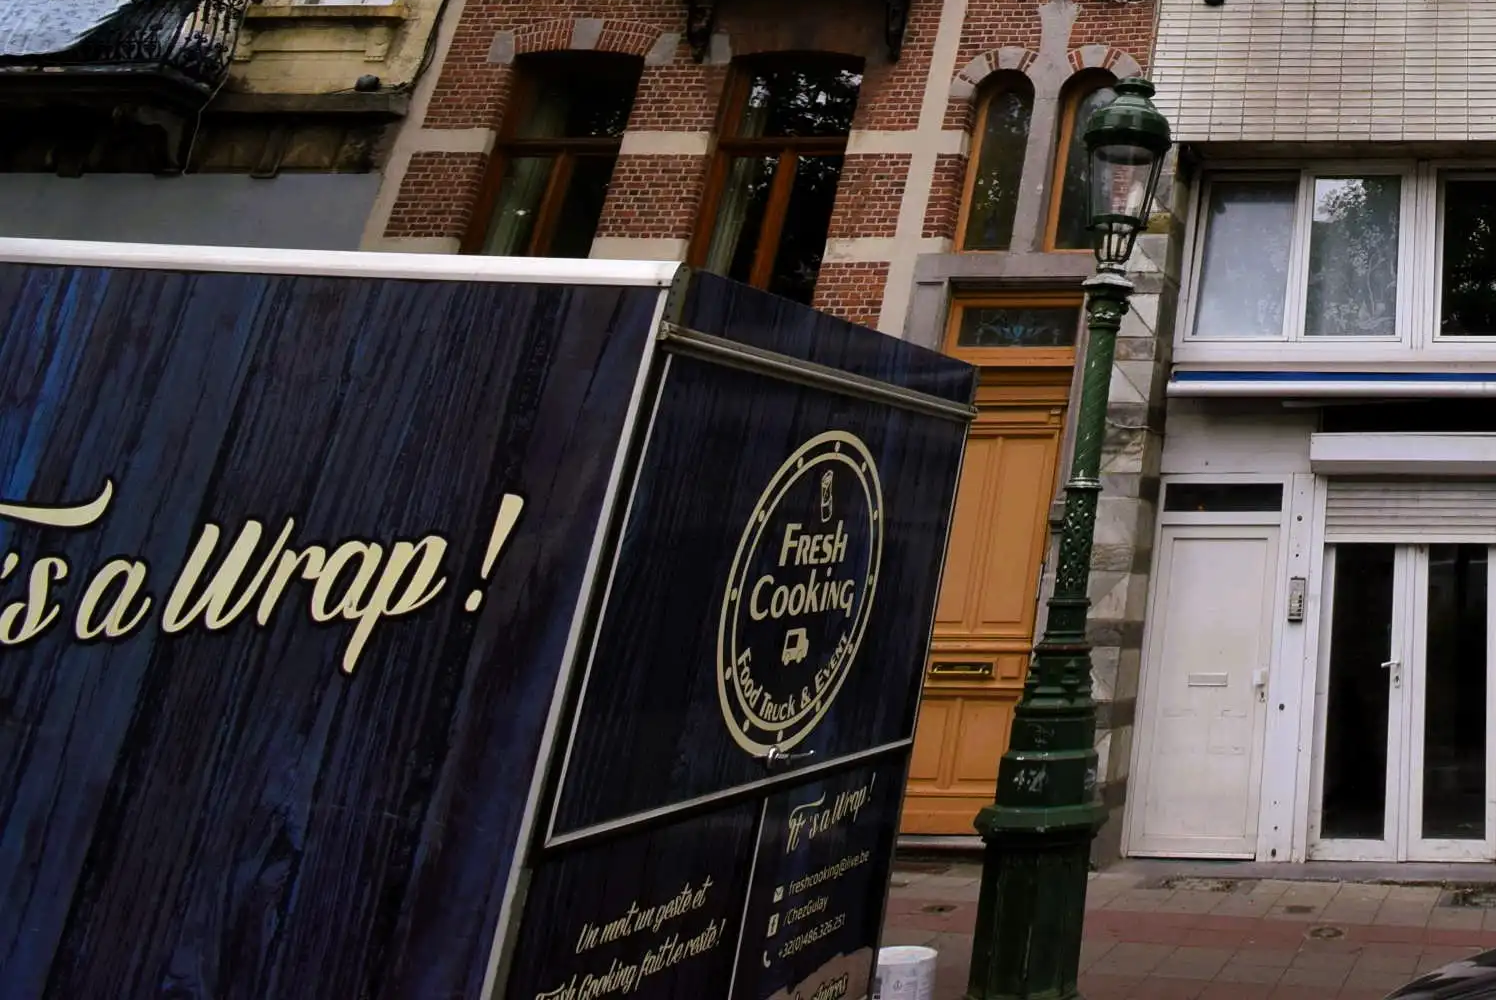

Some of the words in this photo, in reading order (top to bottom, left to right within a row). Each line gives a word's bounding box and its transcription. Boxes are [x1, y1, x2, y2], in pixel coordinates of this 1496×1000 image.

[76, 558, 151, 640] a
[800, 686, 812, 709] &
[819, 808, 830, 833] a
[575, 922, 600, 954] Un
[634, 906, 655, 932] un
[652, 882, 692, 933] geste
[691, 875, 713, 909] et
[578, 957, 638, 995] Cooking
[634, 937, 672, 991] fait
[666, 932, 684, 967] le
